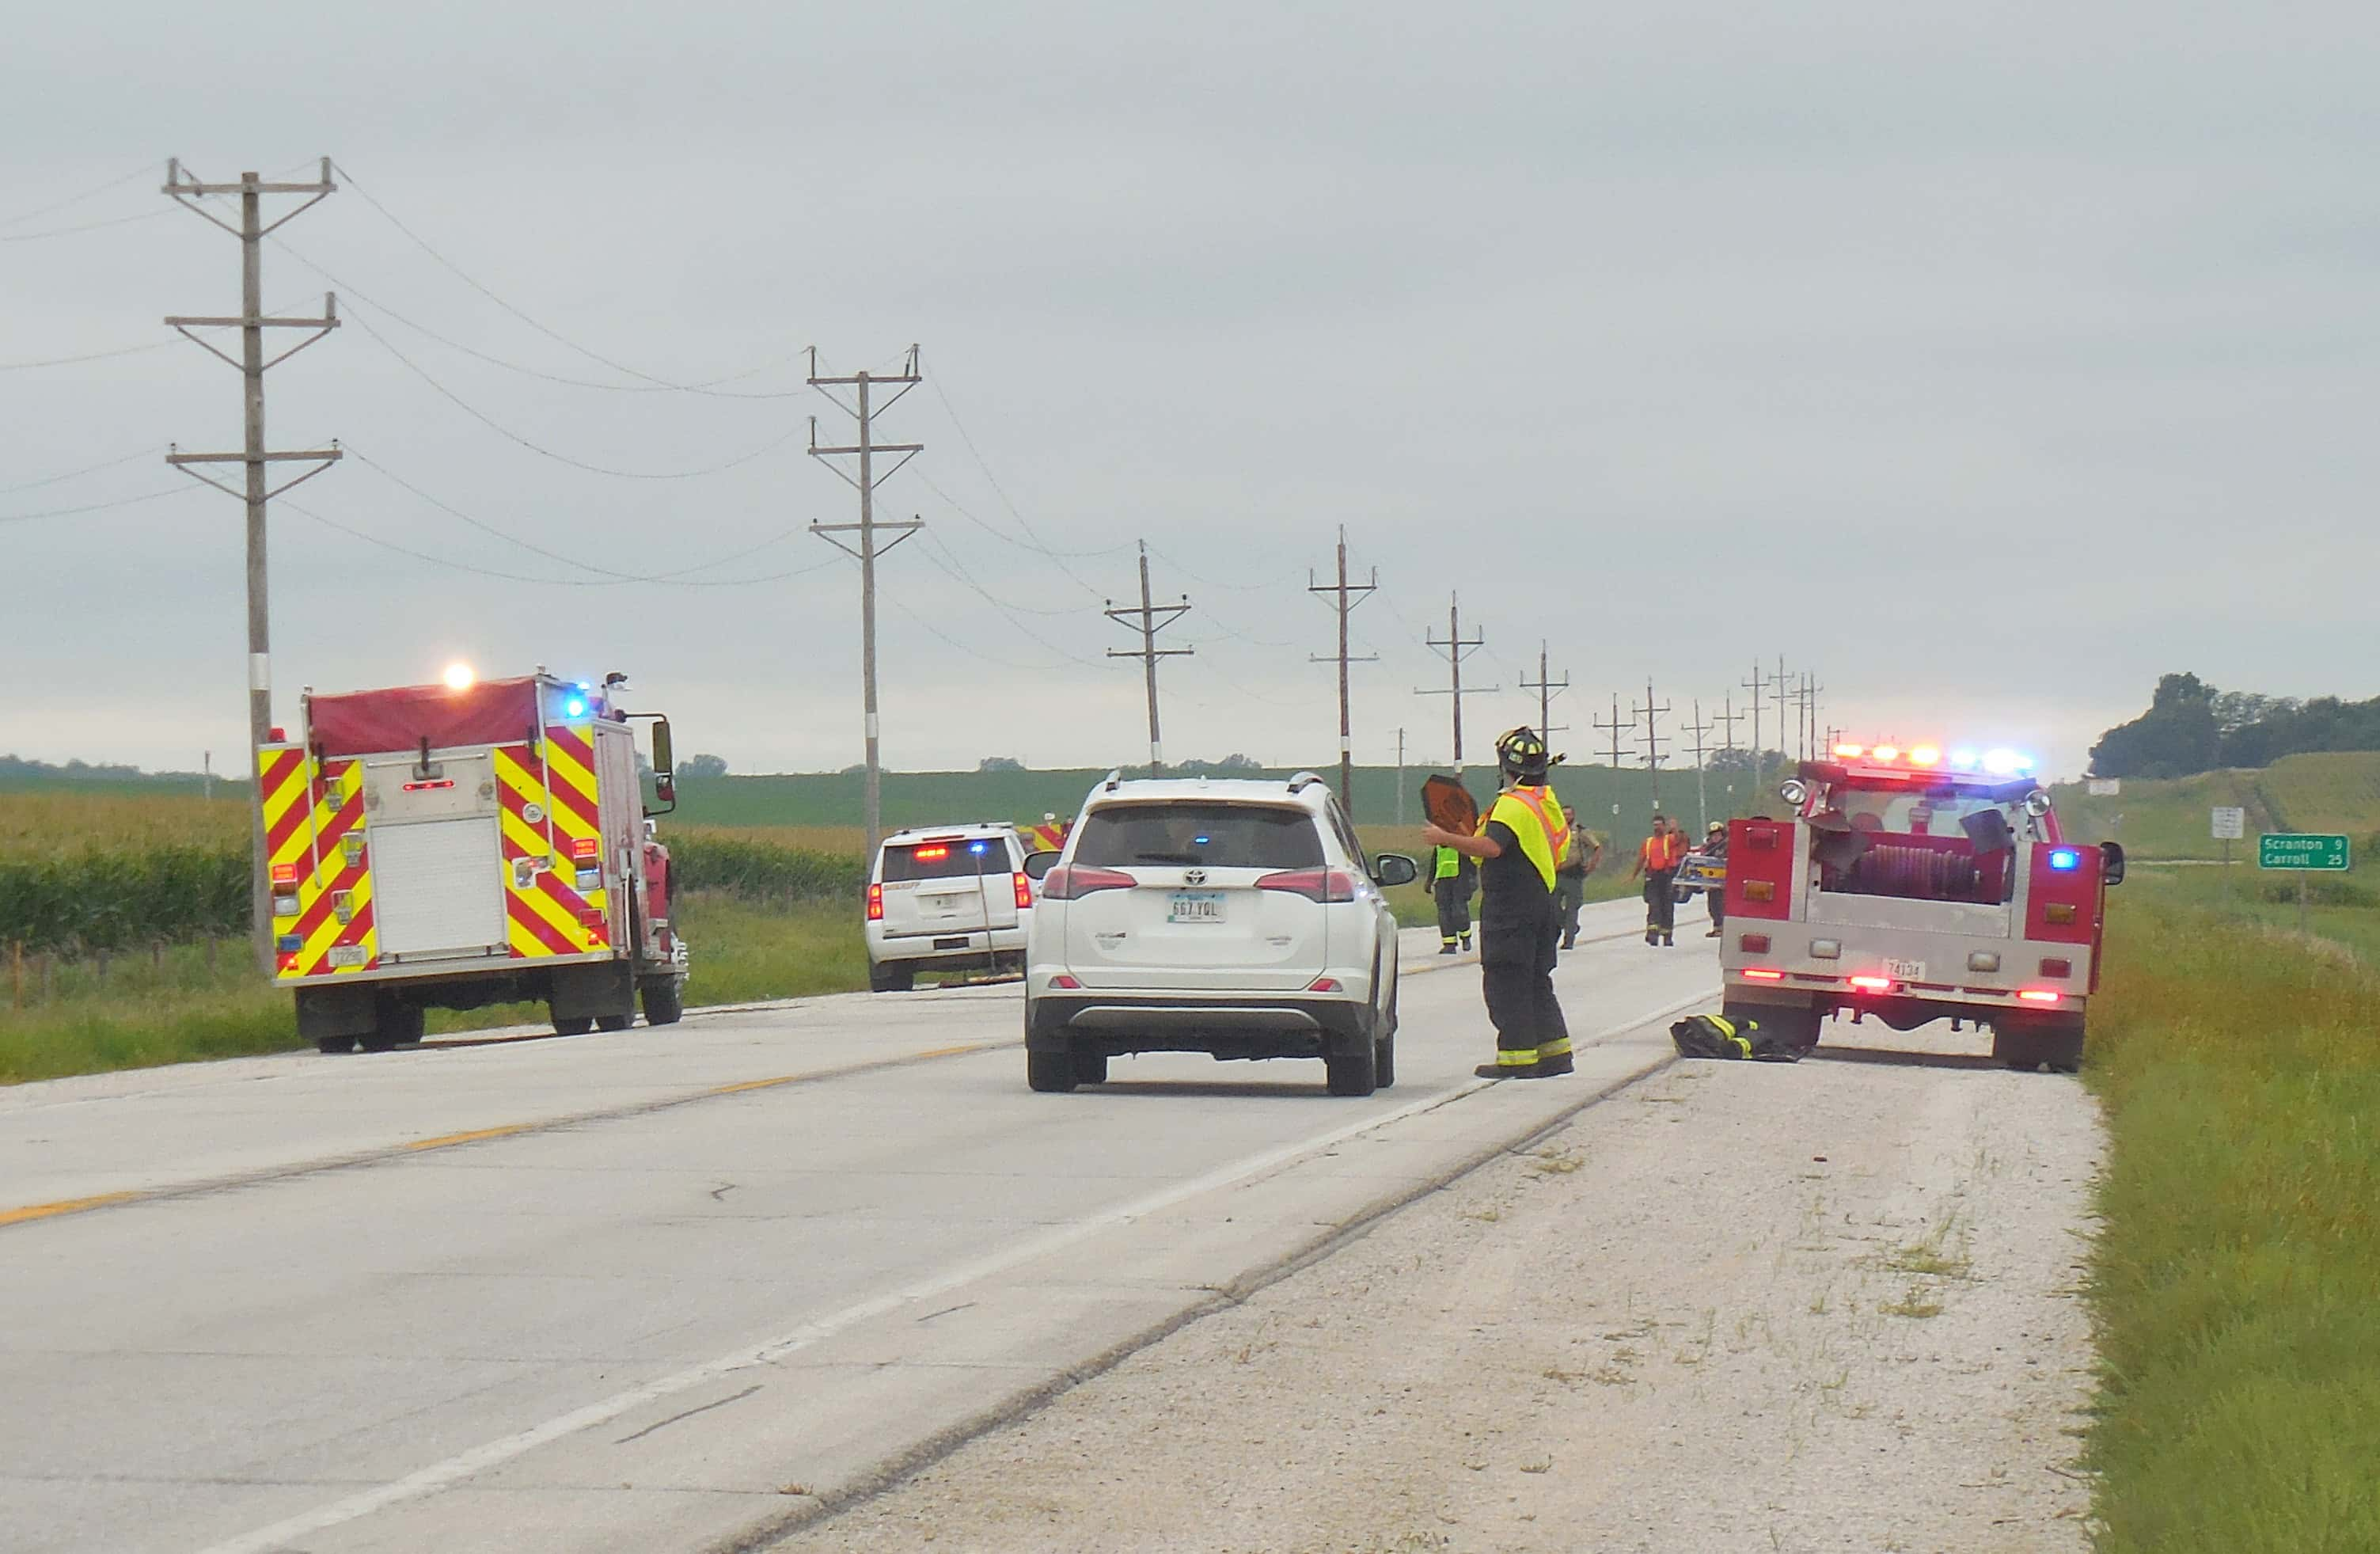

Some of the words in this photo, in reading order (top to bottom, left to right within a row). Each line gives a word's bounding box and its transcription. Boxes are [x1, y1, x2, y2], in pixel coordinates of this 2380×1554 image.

[2264, 838, 2323, 850] Scranton
[2335, 839, 2343, 850] 9
[2265, 853, 2310, 865] Carroll
[2328, 854, 2343, 865] 25
